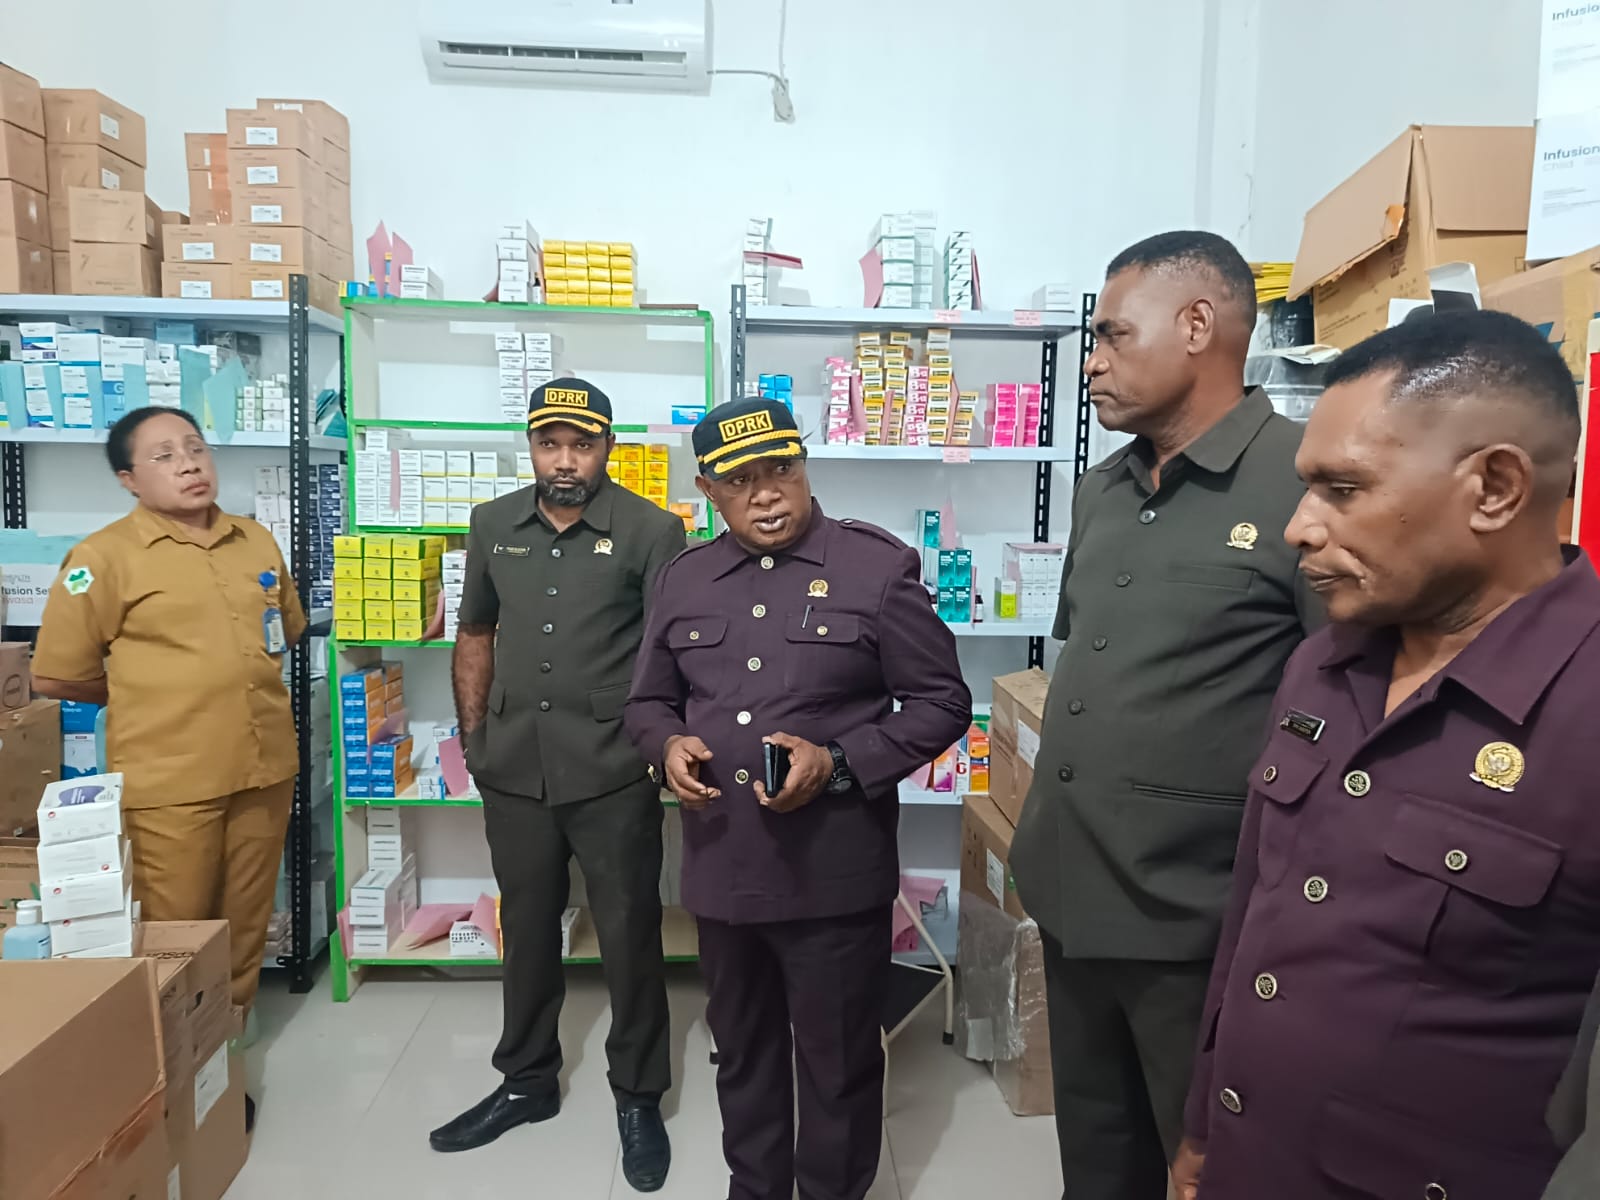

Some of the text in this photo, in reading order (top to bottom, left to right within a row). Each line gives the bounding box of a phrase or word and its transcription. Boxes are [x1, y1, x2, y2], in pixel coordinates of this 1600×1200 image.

[1543, 145, 1600, 161] Infusion
[549, 391, 584, 405] DPRK
[724, 413, 768, 438] DPRK
